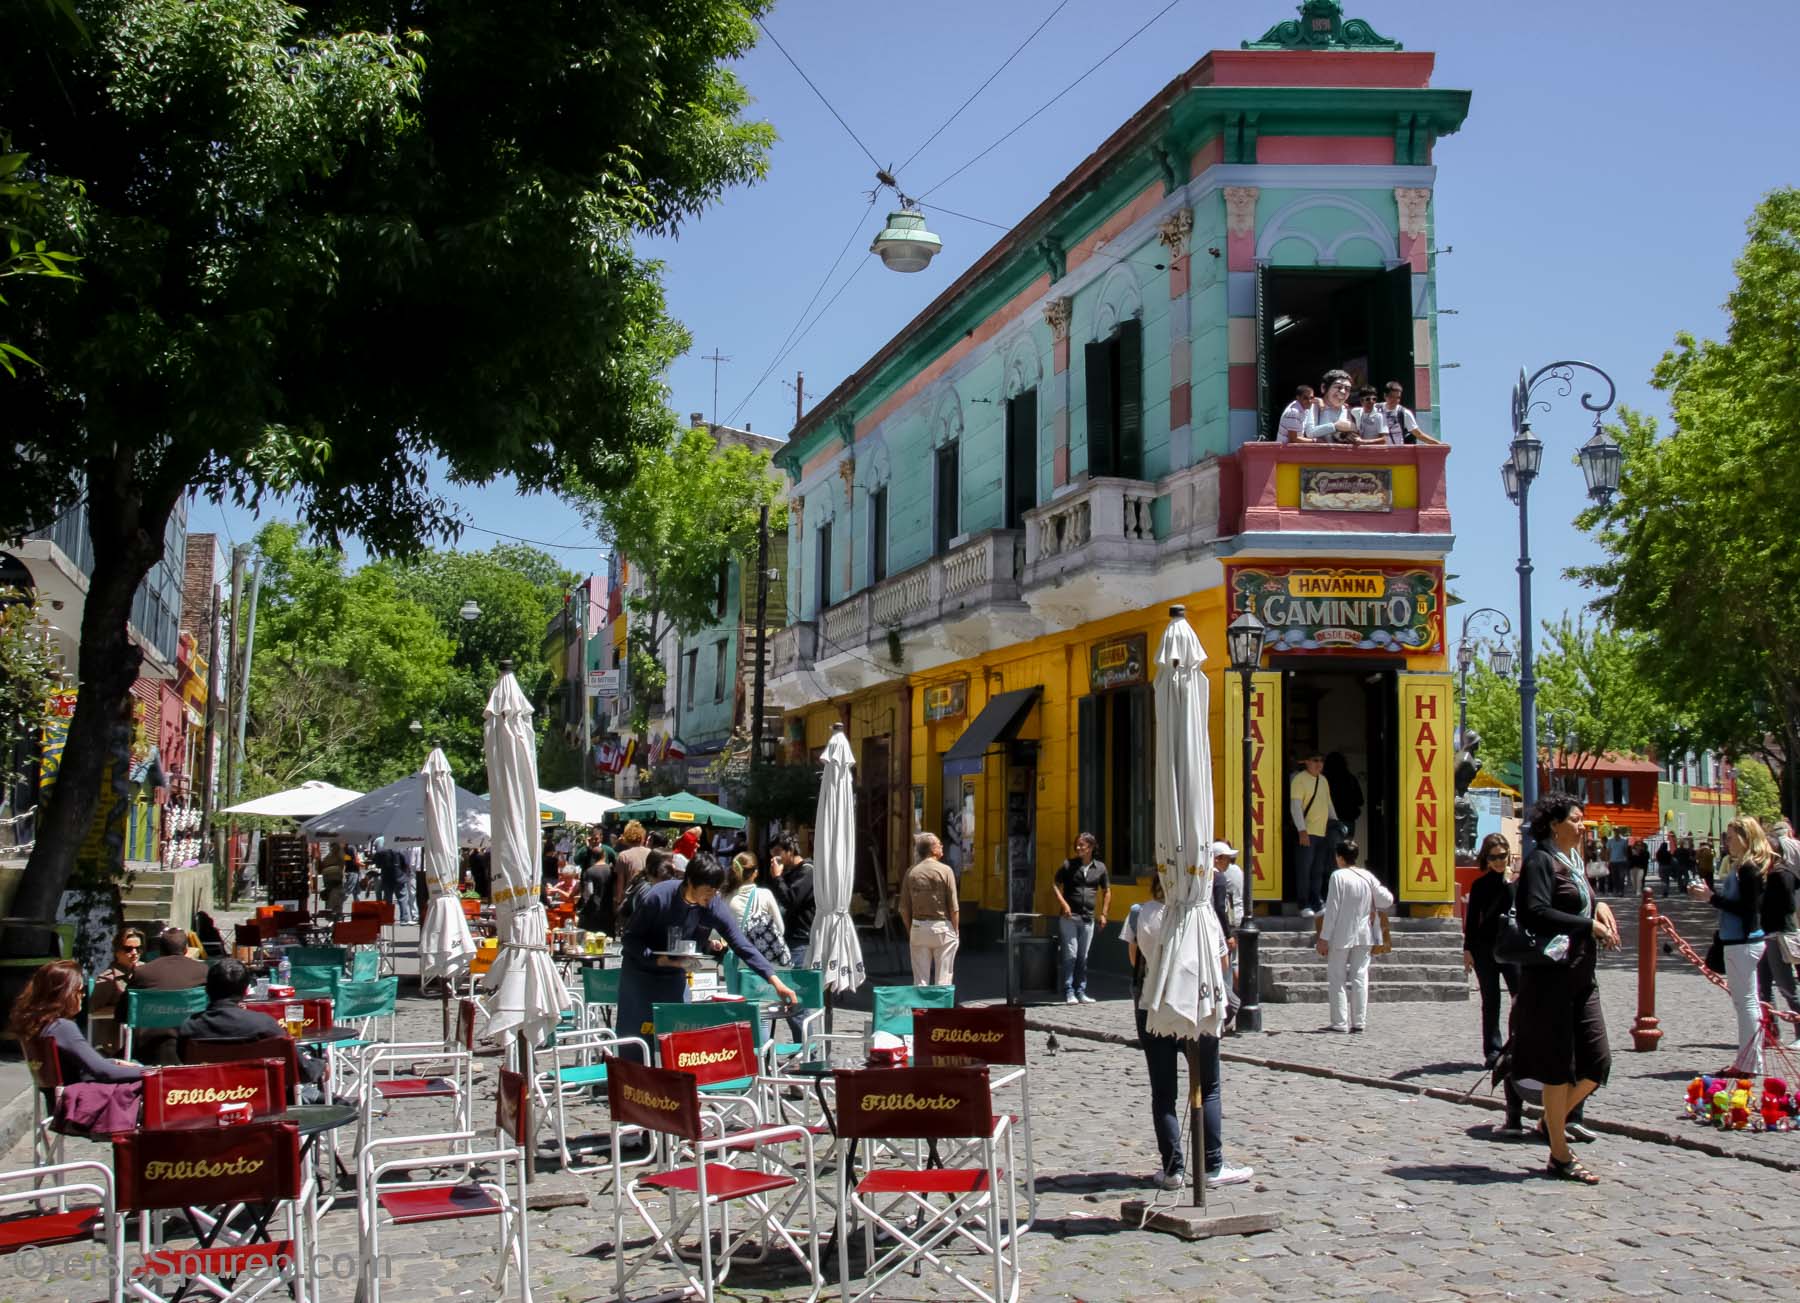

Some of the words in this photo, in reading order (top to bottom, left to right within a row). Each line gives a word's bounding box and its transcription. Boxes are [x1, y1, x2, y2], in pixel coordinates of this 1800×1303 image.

[1299, 578, 1377, 593] HAVANNA
[1263, 595, 1412, 627] CAMINITO
[1415, 695, 1438, 882] HAVANNA
[931, 1028, 1004, 1043] Filiberto
[678, 1048, 738, 1067] Filiberto
[166, 1084, 258, 1105] Filiberto
[623, 1084, 680, 1111] Filiberto
[860, 1093, 961, 1111] Filiberto
[145, 1156, 264, 1180] Filiberto
